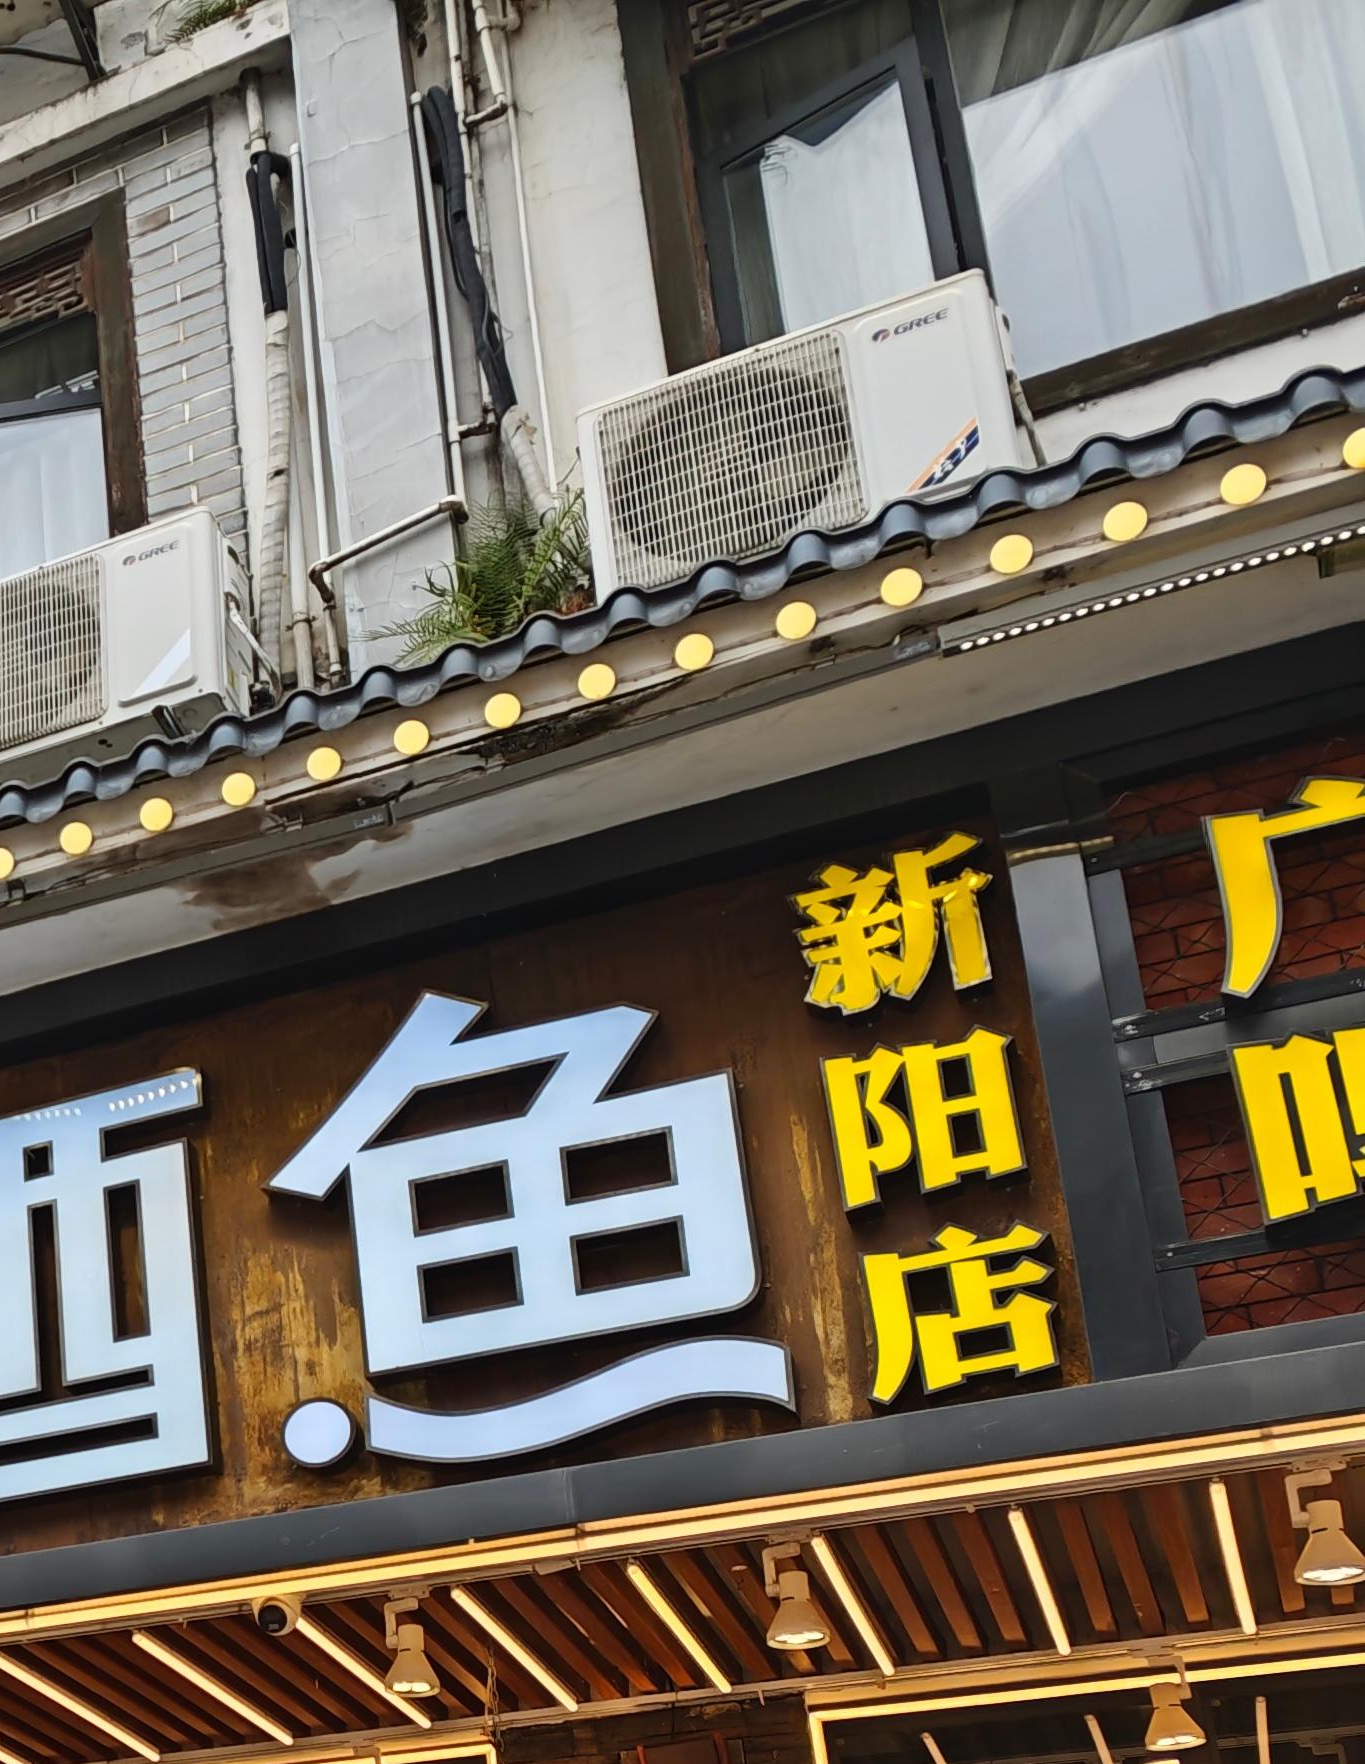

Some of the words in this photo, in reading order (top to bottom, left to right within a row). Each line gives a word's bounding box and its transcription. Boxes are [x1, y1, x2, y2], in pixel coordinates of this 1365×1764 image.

[893, 306, 949, 337] GREE
[137, 539, 180, 562] GREE
[793, 830, 1061, 1406] 新阳店
